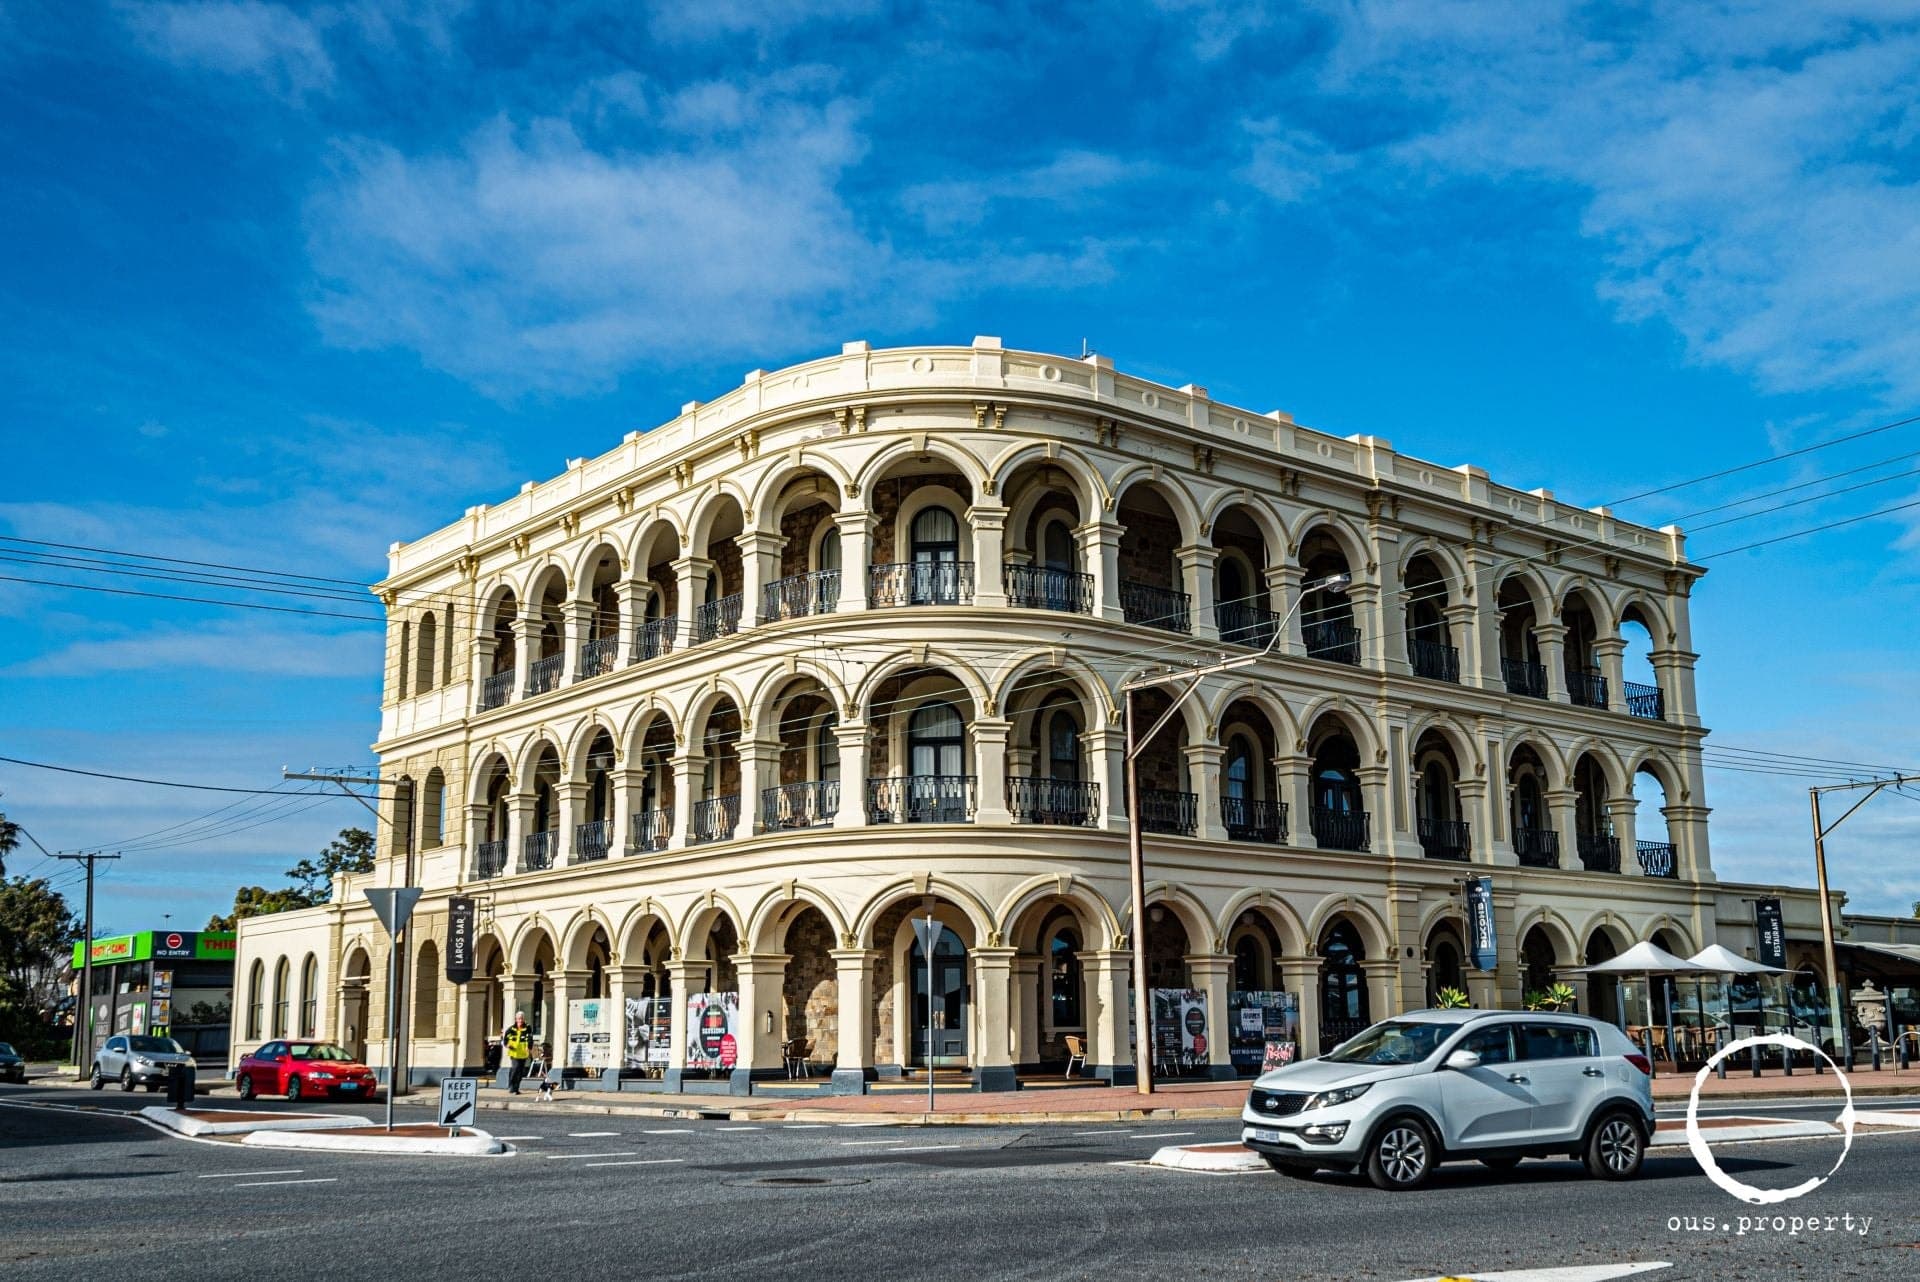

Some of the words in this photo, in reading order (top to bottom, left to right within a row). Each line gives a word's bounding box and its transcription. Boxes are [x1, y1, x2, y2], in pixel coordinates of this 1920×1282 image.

[455, 917, 466, 935] BAR
[1770, 918, 1780, 957] RESTAURANT
[455, 937, 465, 965] LARGS
[448, 1082, 472, 1090] KEEP
[448, 1092, 470, 1100] LEFT
